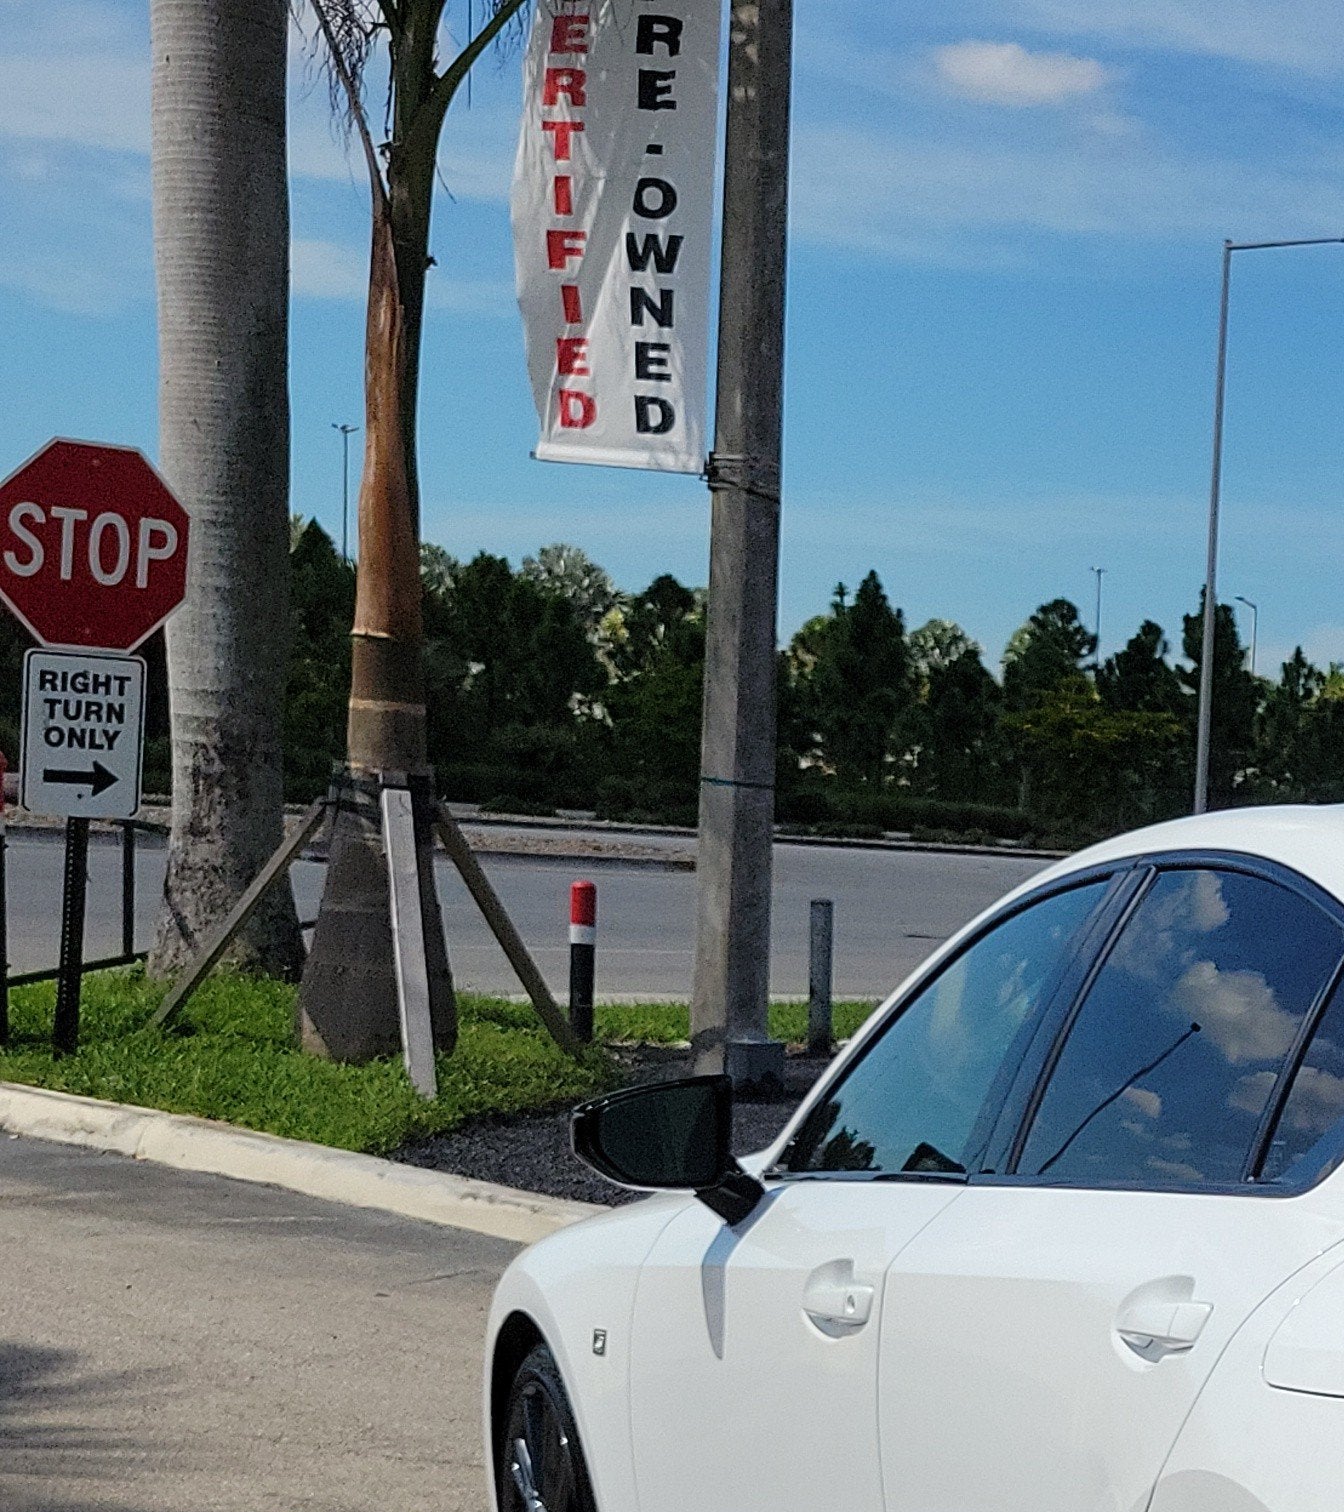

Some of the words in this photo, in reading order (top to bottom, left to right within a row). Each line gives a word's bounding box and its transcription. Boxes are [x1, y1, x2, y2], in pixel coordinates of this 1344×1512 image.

[541, 0, 598, 429] ERTIFIED
[625, 0, 684, 435] RE-OWNED
[4, 502, 178, 588] STOP
[39, 669, 132, 696] RIGHT
[43, 698, 125, 724] TURN
[43, 725, 122, 750] ONLY
